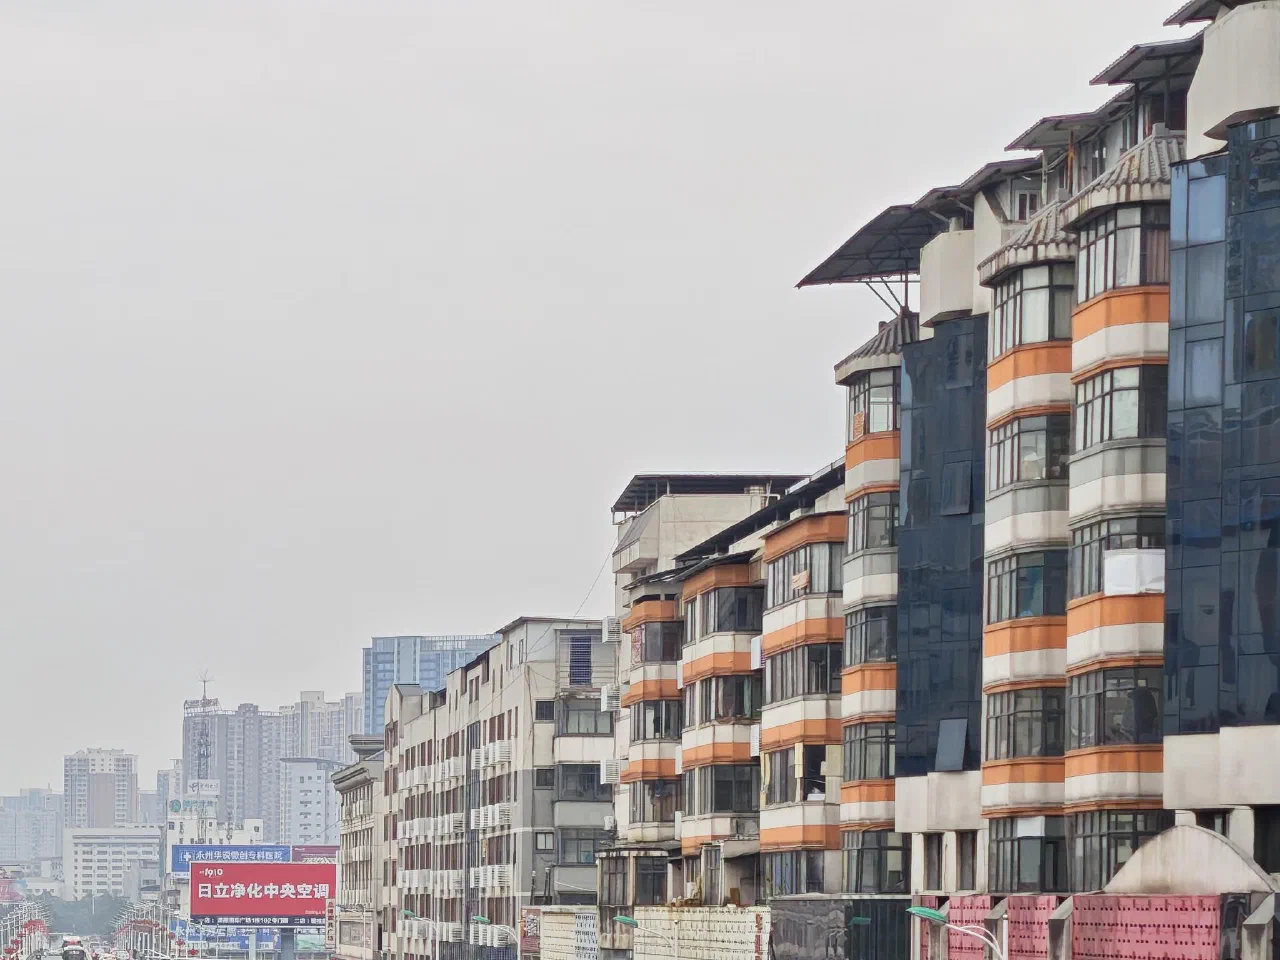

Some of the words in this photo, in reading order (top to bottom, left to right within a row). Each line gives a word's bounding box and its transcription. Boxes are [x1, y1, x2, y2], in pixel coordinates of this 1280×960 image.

[198, 883, 330, 899] 日立净化中央空调
